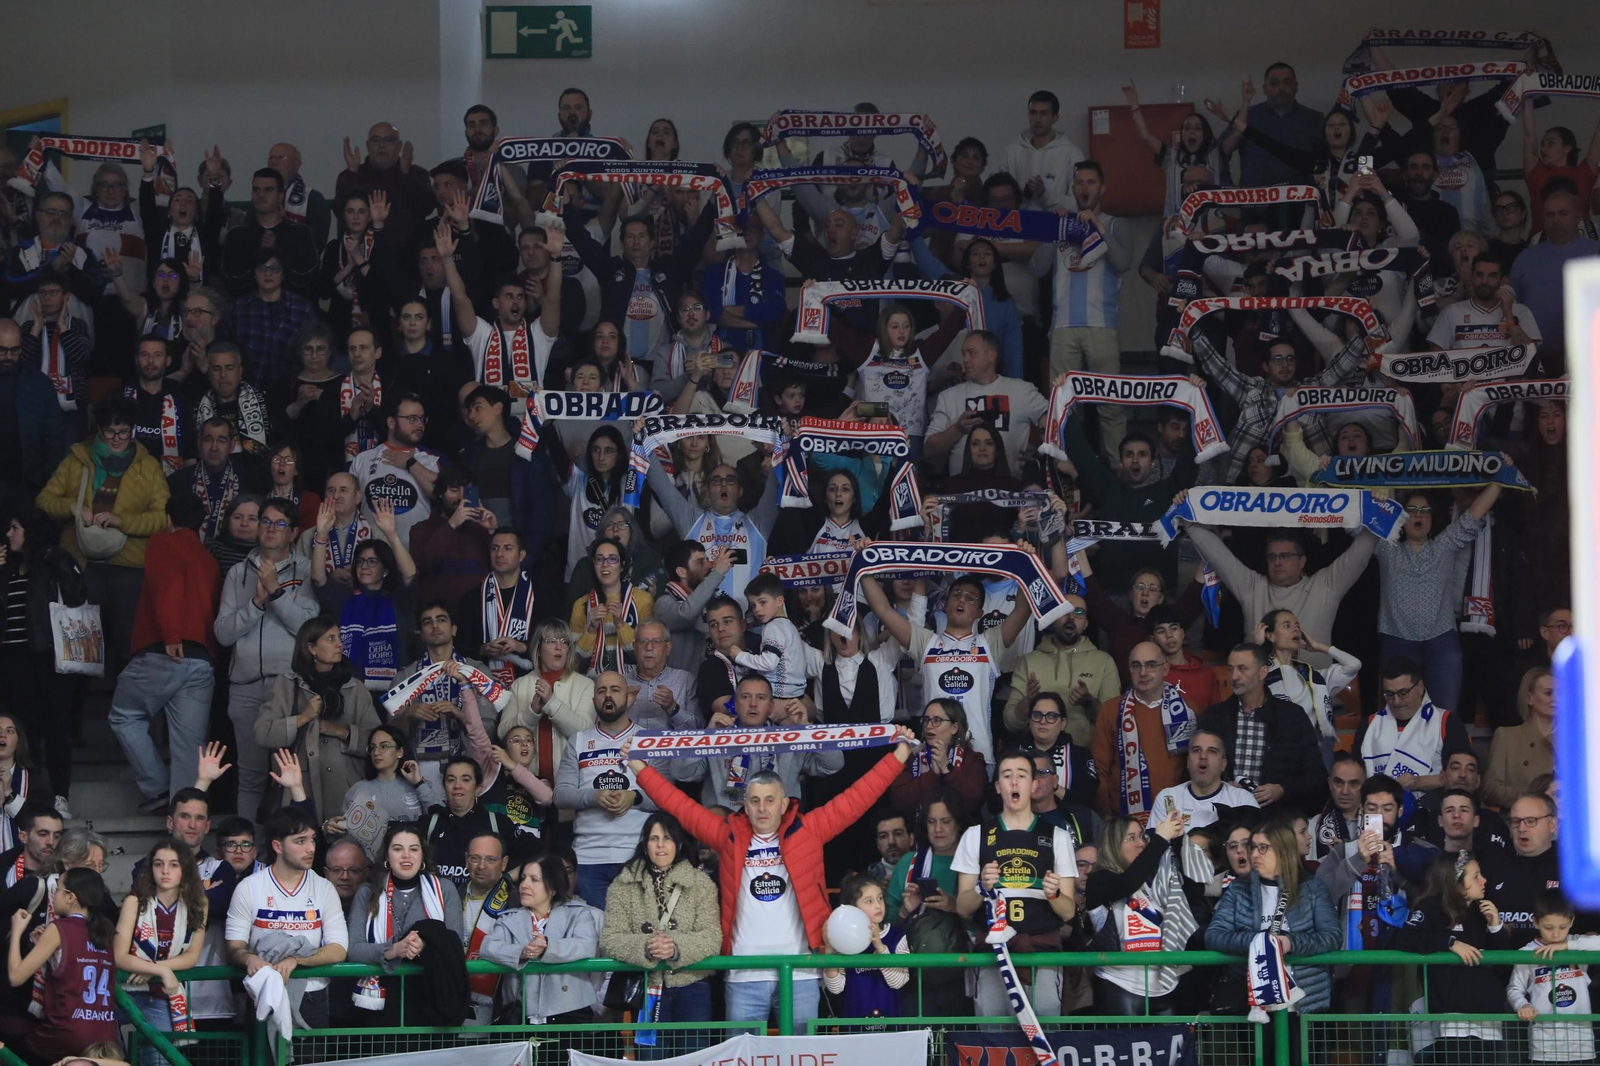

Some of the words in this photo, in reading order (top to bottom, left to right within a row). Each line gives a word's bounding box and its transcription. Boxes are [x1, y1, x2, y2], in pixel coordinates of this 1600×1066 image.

[1373, 29, 1487, 39] BRADOIRO
[1348, 64, 1475, 89] OBRADOIRO
[1539, 73, 1600, 92] OBRADOIR
[777, 114, 901, 129] OBRADOIRO
[501, 142, 611, 159] OBRADOIRO
[857, 169, 901, 178] OBRA
[932, 201, 1022, 233] OBRA
[1275, 247, 1400, 283] OBRA
[842, 278, 968, 296] OBRADOIRO
[628, 301, 653, 309] Estrella
[1464, 333, 1506, 341] OBRADOIRO
[1072, 377, 1178, 399] OBRADOIRO
[1485, 382, 1570, 401] OBRADO
[1297, 388, 1397, 406] OBRADOIRO
[545, 393, 664, 417] OBRADO
[645, 413, 780, 435] BRADOIR
[800, 437, 909, 457] OBRADOIRO
[1335, 456, 1404, 476] LIVING
[369, 483, 411, 497] Estrella
[1200, 491, 1349, 513] OBRADOIRO
[1298, 515, 1344, 524] #SomosObra
[700, 533, 748, 544] OBRADOIRO
[801, 552, 848, 562] xuntos
[862, 548, 1004, 566] OBRADOIRO
[913, 570, 936, 578] OBRA
[793, 579, 816, 587] OBRA
[936, 654, 978, 663] OBRADOIRO
[944, 674, 969, 682] Estrella
[944, 680, 969, 688] Galicia
[661, 729, 705, 737] Todos
[714, 727, 766, 735] xuntos
[637, 732, 801, 749] OBRADOIRO
[742, 746, 769, 754] OBRA
[790, 743, 817, 752] OBRA
[837, 741, 864, 749] OBRA
[588, 759, 620, 767] OBRADO
[598, 776, 624, 784] Estrella
[996, 848, 1039, 858] OBRADOIRO
[744, 858, 784, 867] OBRADOIR
[1003, 866, 1031, 874] Estrella
[1003, 873, 1030, 882] Galicia
[754, 878, 781, 888] Estrella
[755, 886, 781, 895] Galicia
[1009, 900, 1025, 922] 6
[268, 921, 314, 930] OBRADOIRO
[1127, 941, 1159, 950] OBRADOIRO
[1542, 972, 1576, 982] OBADOIRO
[83, 966, 111, 1006] 34
[1271, 979, 1281, 1004] 24/25
